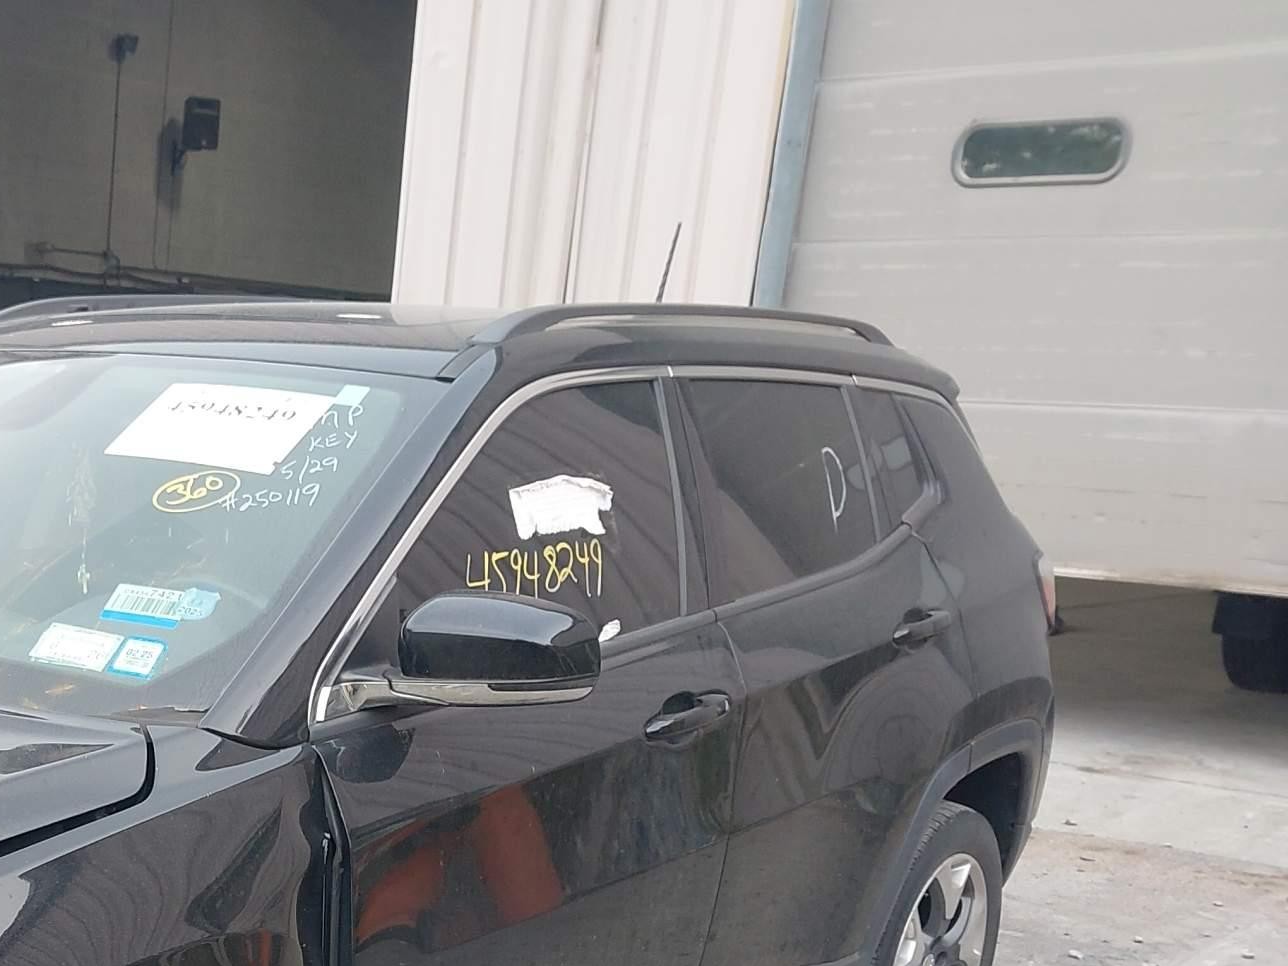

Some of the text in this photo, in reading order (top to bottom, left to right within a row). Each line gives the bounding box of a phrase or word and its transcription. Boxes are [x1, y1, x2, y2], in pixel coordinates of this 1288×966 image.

[308, 429, 358, 451] KEY
[280, 455, 338, 484] 5/29
[165, 475, 224, 505] 360
[466, 538, 603, 600] 45948249
